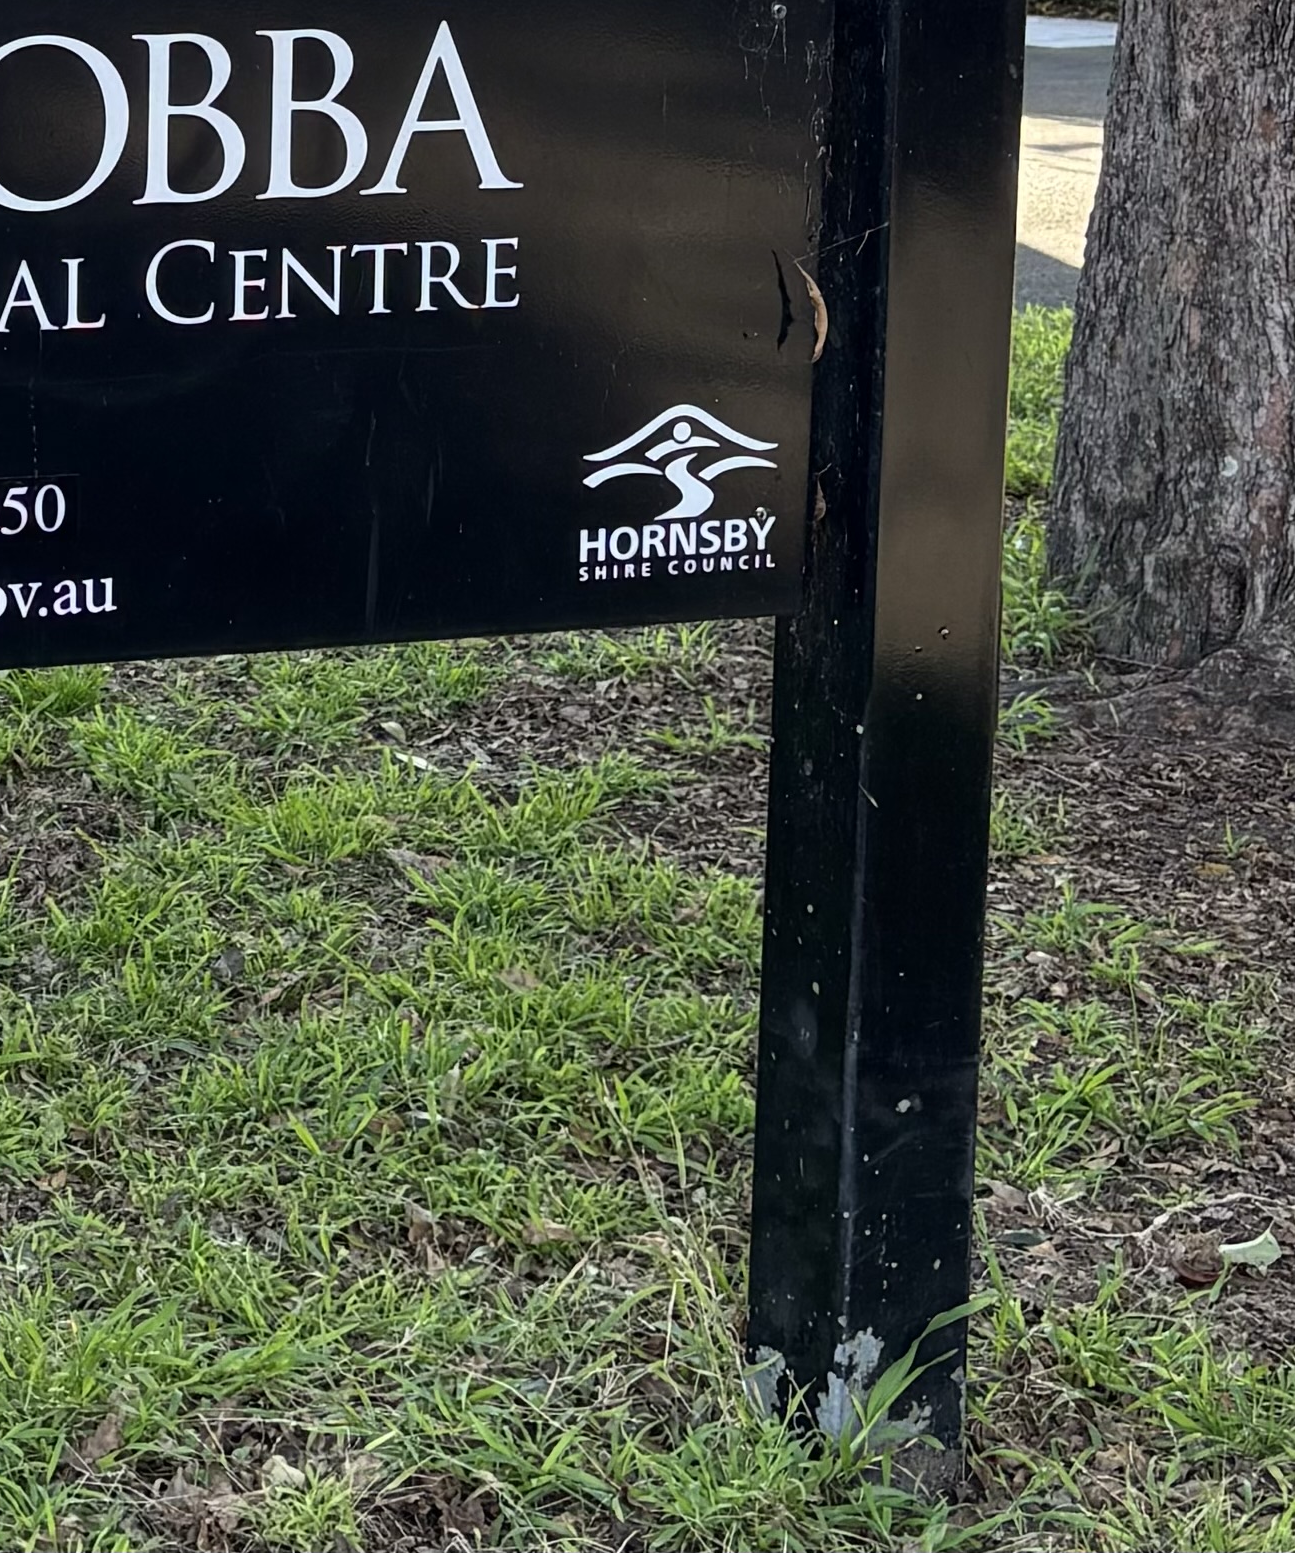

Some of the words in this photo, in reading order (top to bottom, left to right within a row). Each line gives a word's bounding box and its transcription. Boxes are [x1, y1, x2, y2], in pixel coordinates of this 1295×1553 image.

[145, 237, 520, 325] CENTRE
[579, 515, 777, 563] HORNSBY
[579, 560, 652, 582] SHIRE
[667, 553, 776, 576] COUNCIL
